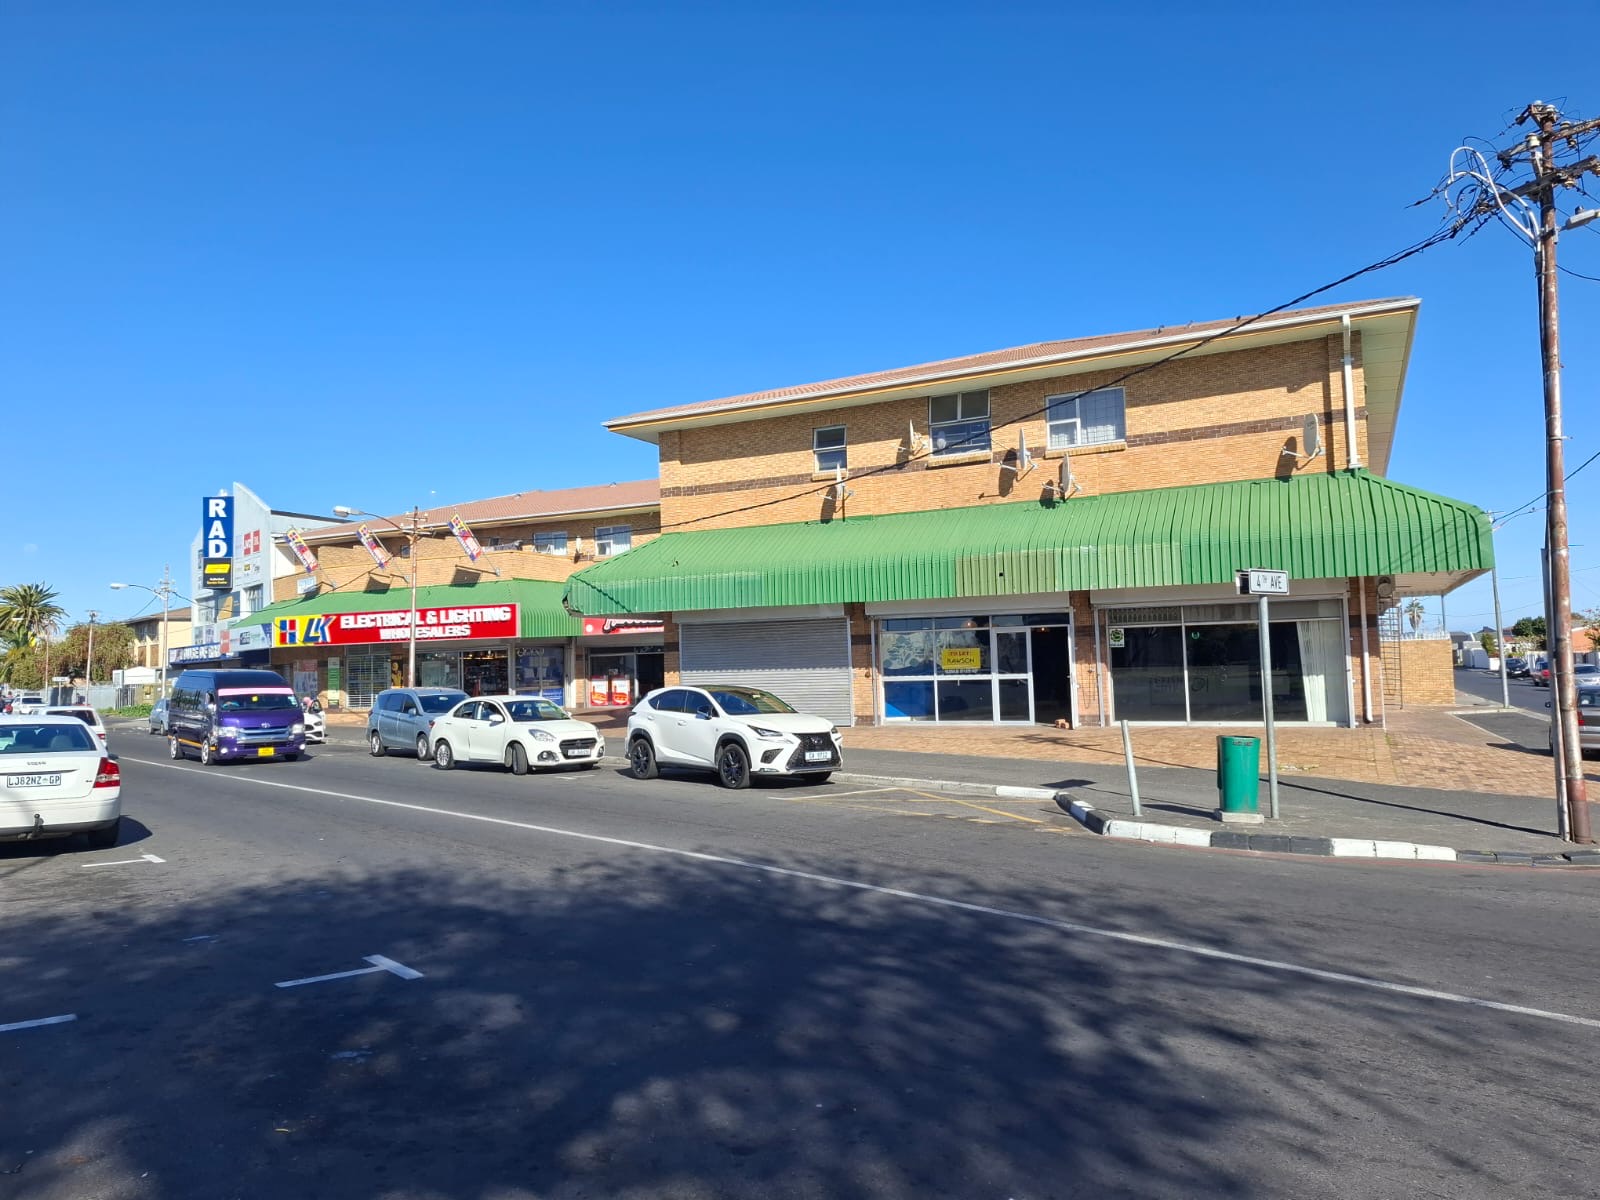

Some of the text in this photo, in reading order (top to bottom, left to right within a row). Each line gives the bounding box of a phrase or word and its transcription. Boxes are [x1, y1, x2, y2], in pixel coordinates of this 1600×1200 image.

[208, 499, 227, 558] RAD
[1271, 576, 1282, 589] AVE
[340, 606, 512, 629] ELECTRICAL & LIGHTING
[379, 625, 471, 640] WHOLESALERS
[9, 775, 60, 785] LJ82NZ GP
